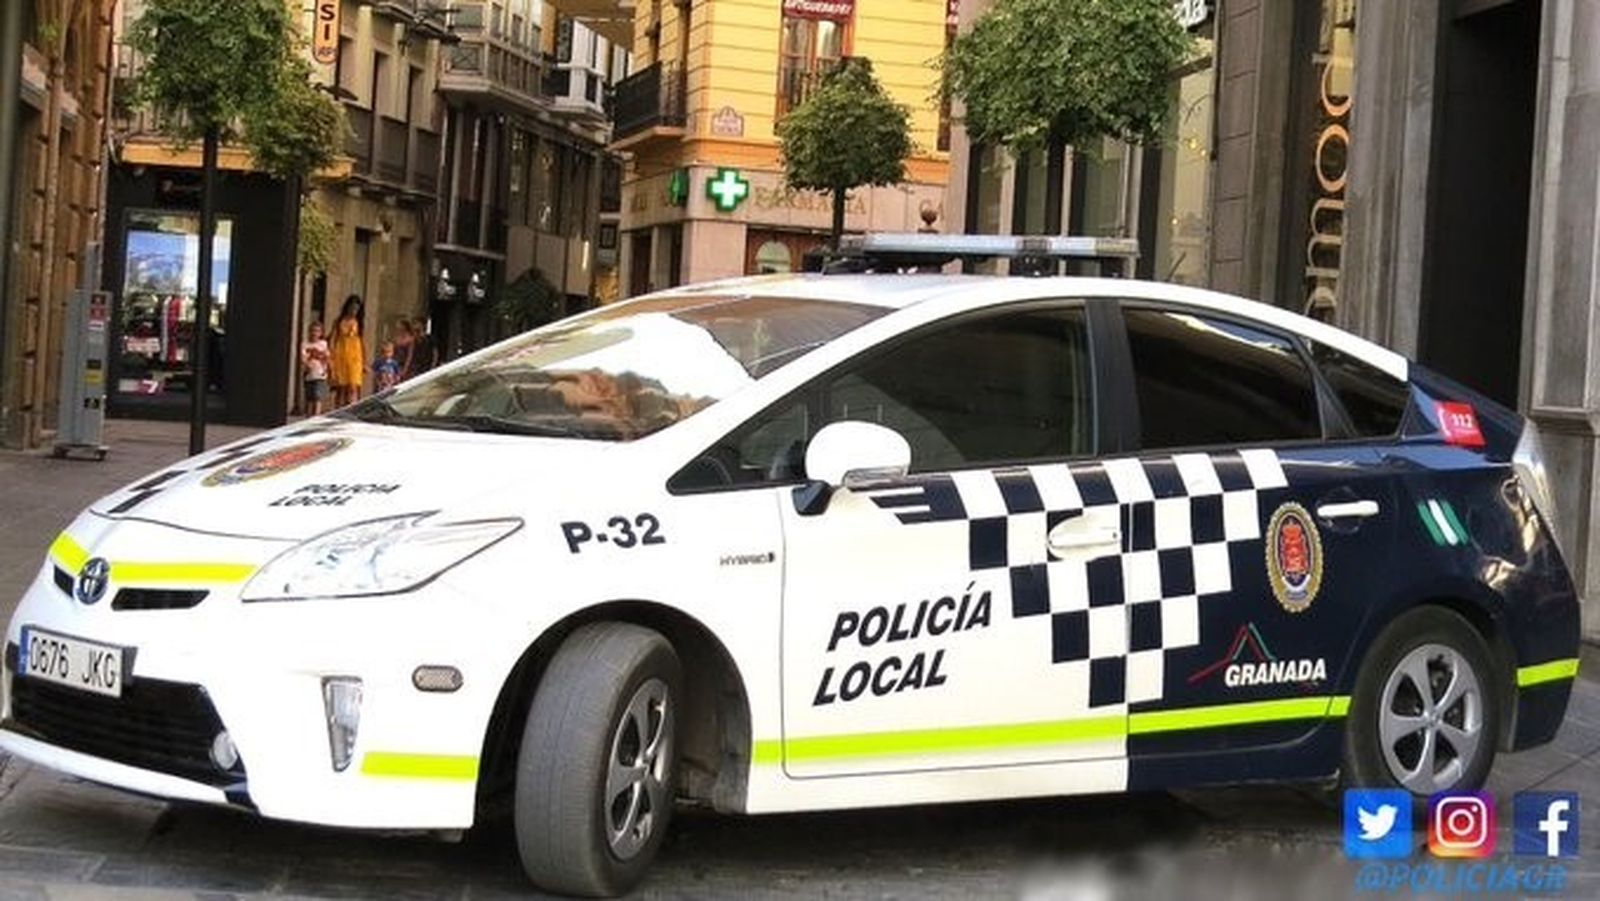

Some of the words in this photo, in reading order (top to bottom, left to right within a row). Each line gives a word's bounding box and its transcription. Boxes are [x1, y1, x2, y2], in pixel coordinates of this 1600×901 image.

[1452, 413, 1473, 429] 112
[268, 495, 352, 507] LOCAL
[561, 513, 666, 553] P-32
[826, 580, 992, 653] POLICÍA
[31, 636, 69, 679] 0676
[82, 648, 117, 688] JKG
[812, 649, 948, 707] LOCAL
[1225, 658, 1327, 688] GRANADA
